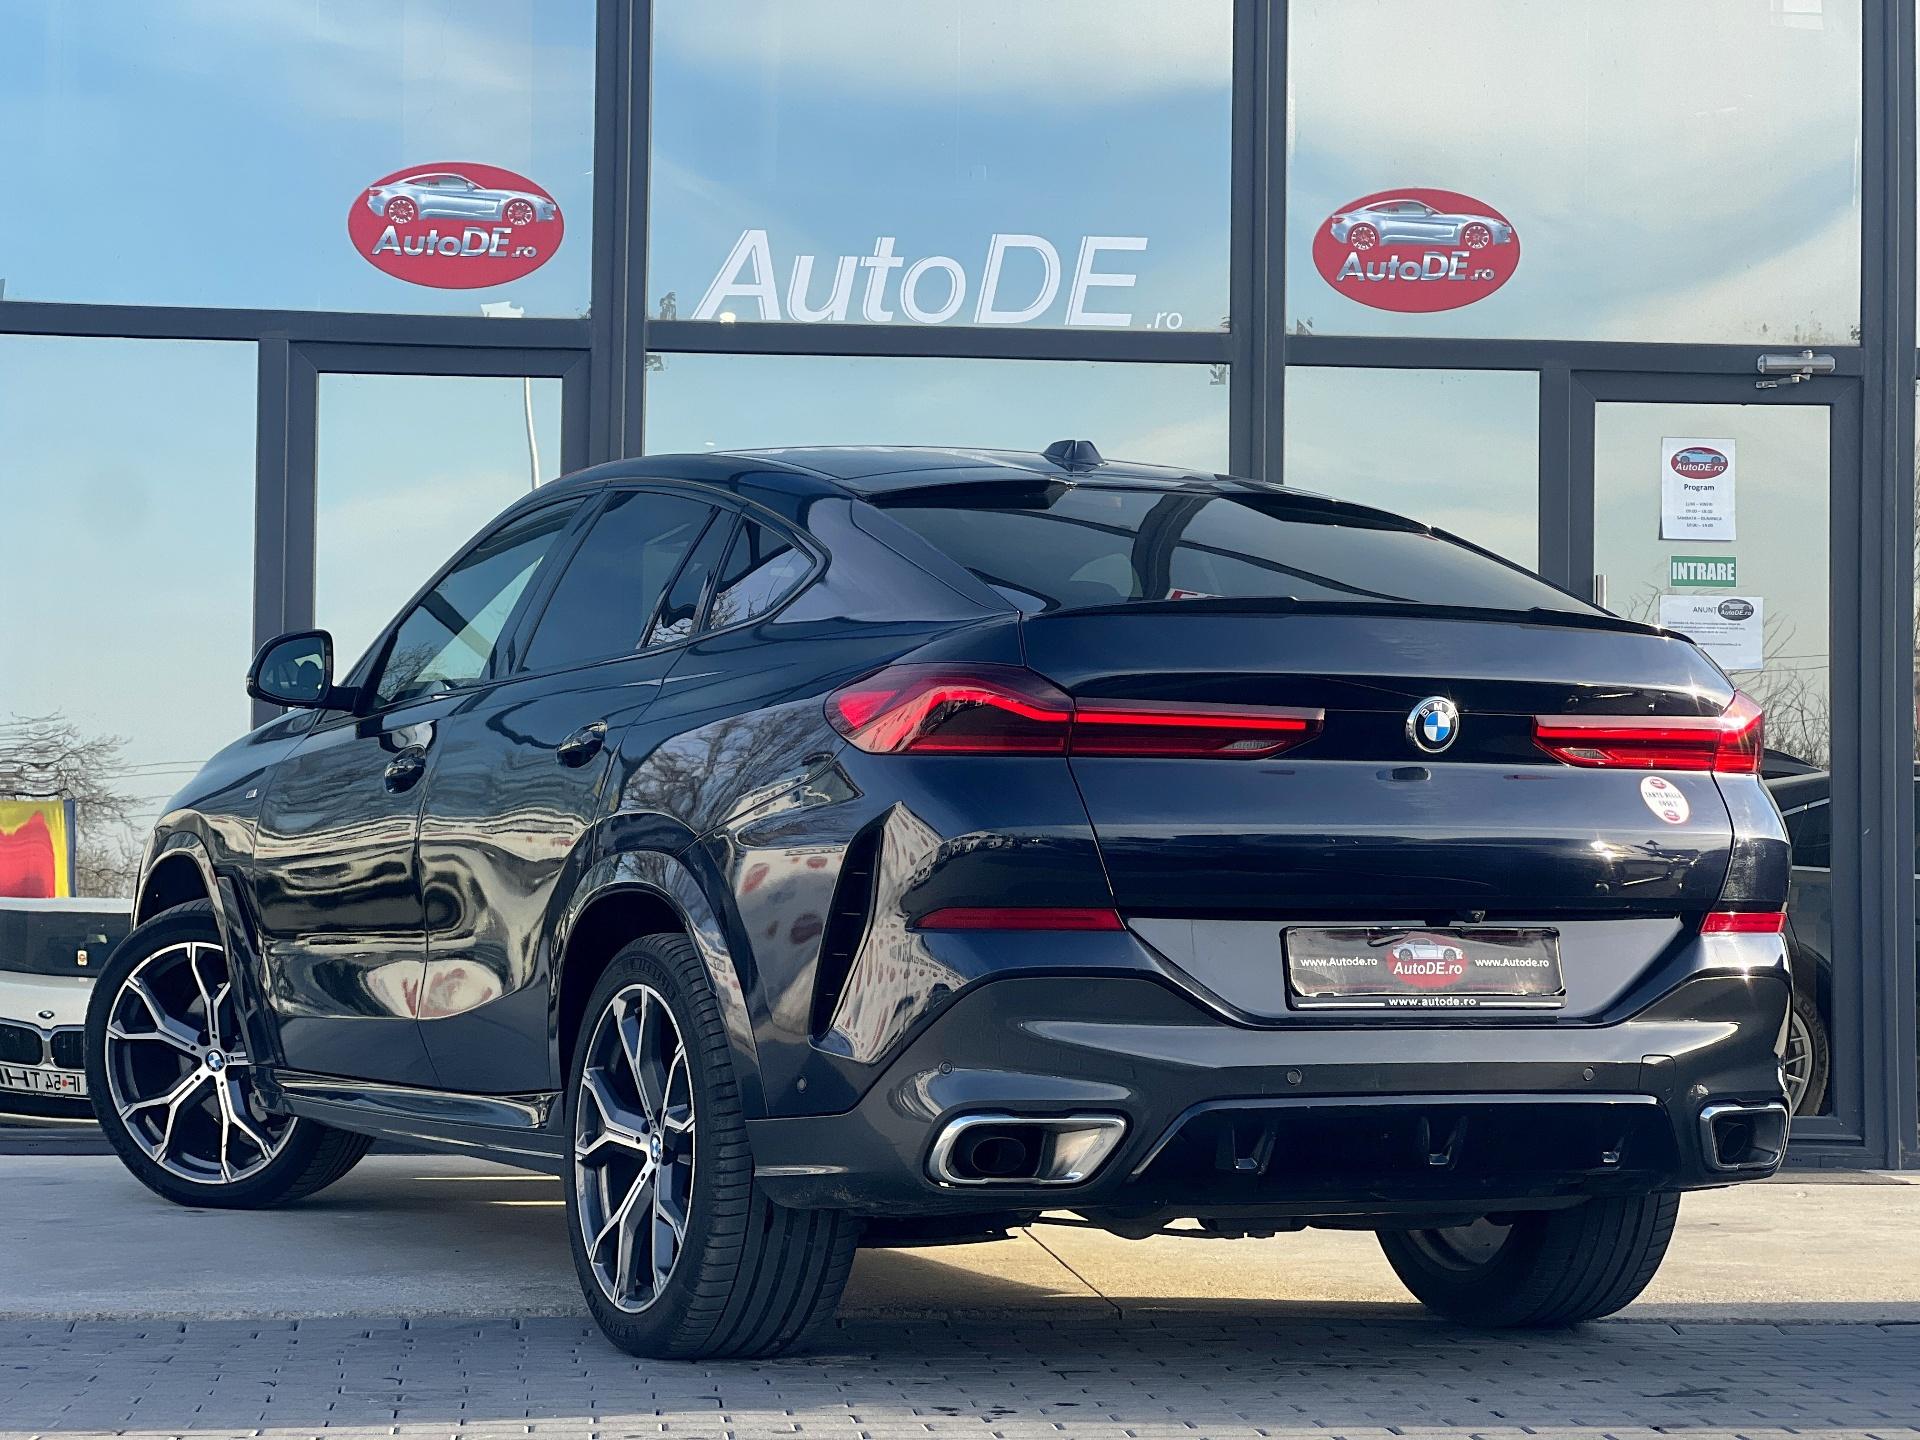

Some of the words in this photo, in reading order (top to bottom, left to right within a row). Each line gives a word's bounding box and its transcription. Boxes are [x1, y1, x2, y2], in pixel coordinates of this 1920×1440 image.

[1675, 463, 1724, 472] AutoDE.ro
[1684, 483, 1715, 492] Program
[1672, 562, 1735, 581] INTRARE
[1300, 957, 1378, 967] www.Autode.ro
[1475, 957, 1550, 968] www.Autode.ro
[1393, 962, 1463, 976] AutoDE.ro
[1388, 997, 1477, 1007] www.autode.ro
